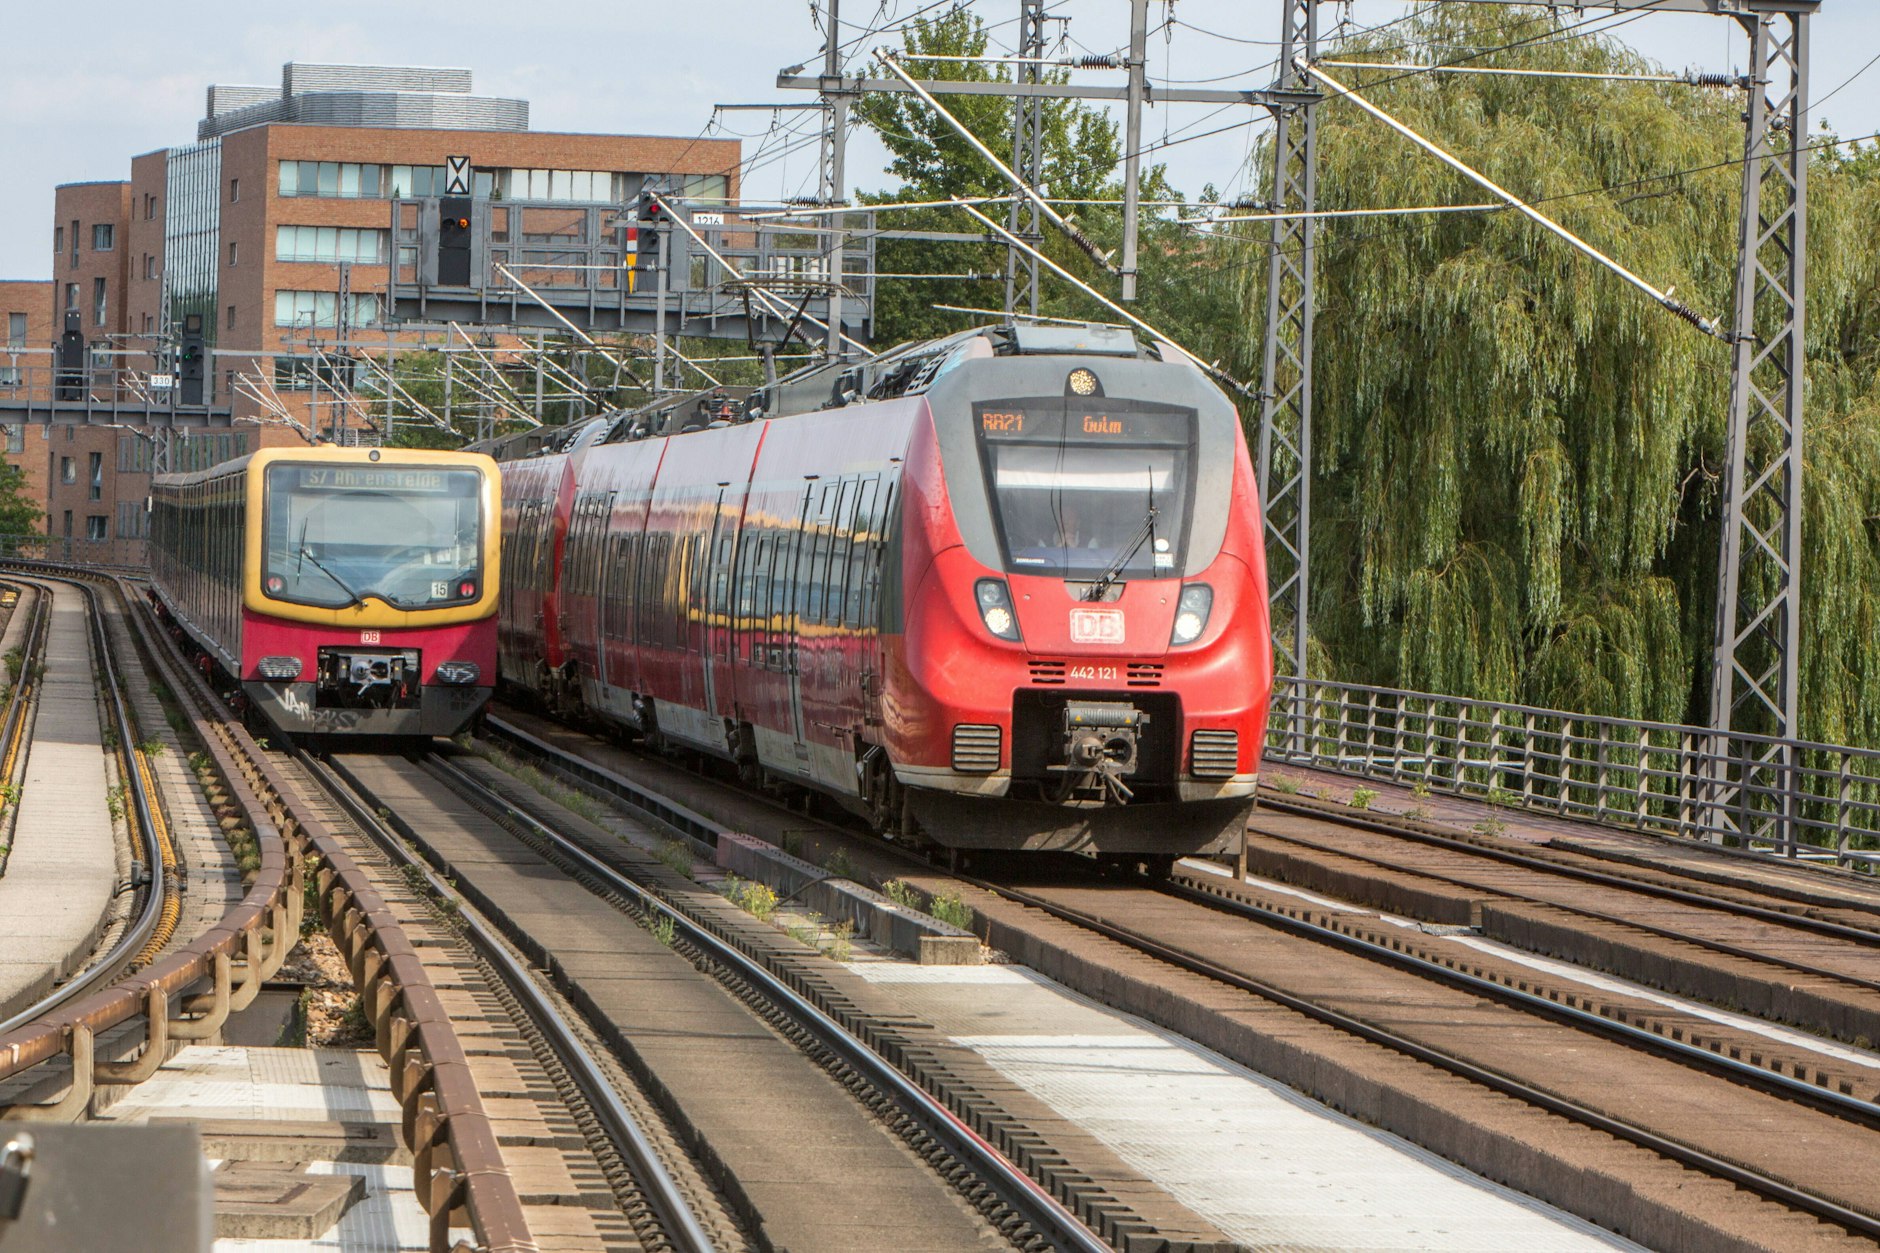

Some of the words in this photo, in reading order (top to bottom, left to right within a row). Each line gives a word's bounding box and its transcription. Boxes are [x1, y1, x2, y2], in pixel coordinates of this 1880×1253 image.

[154, 376, 170, 385] 330
[309, 469, 327, 485] S7
[434, 583, 447, 596] 15
[1070, 666, 1094, 679] 442
[1098, 667, 1117, 680] 121
